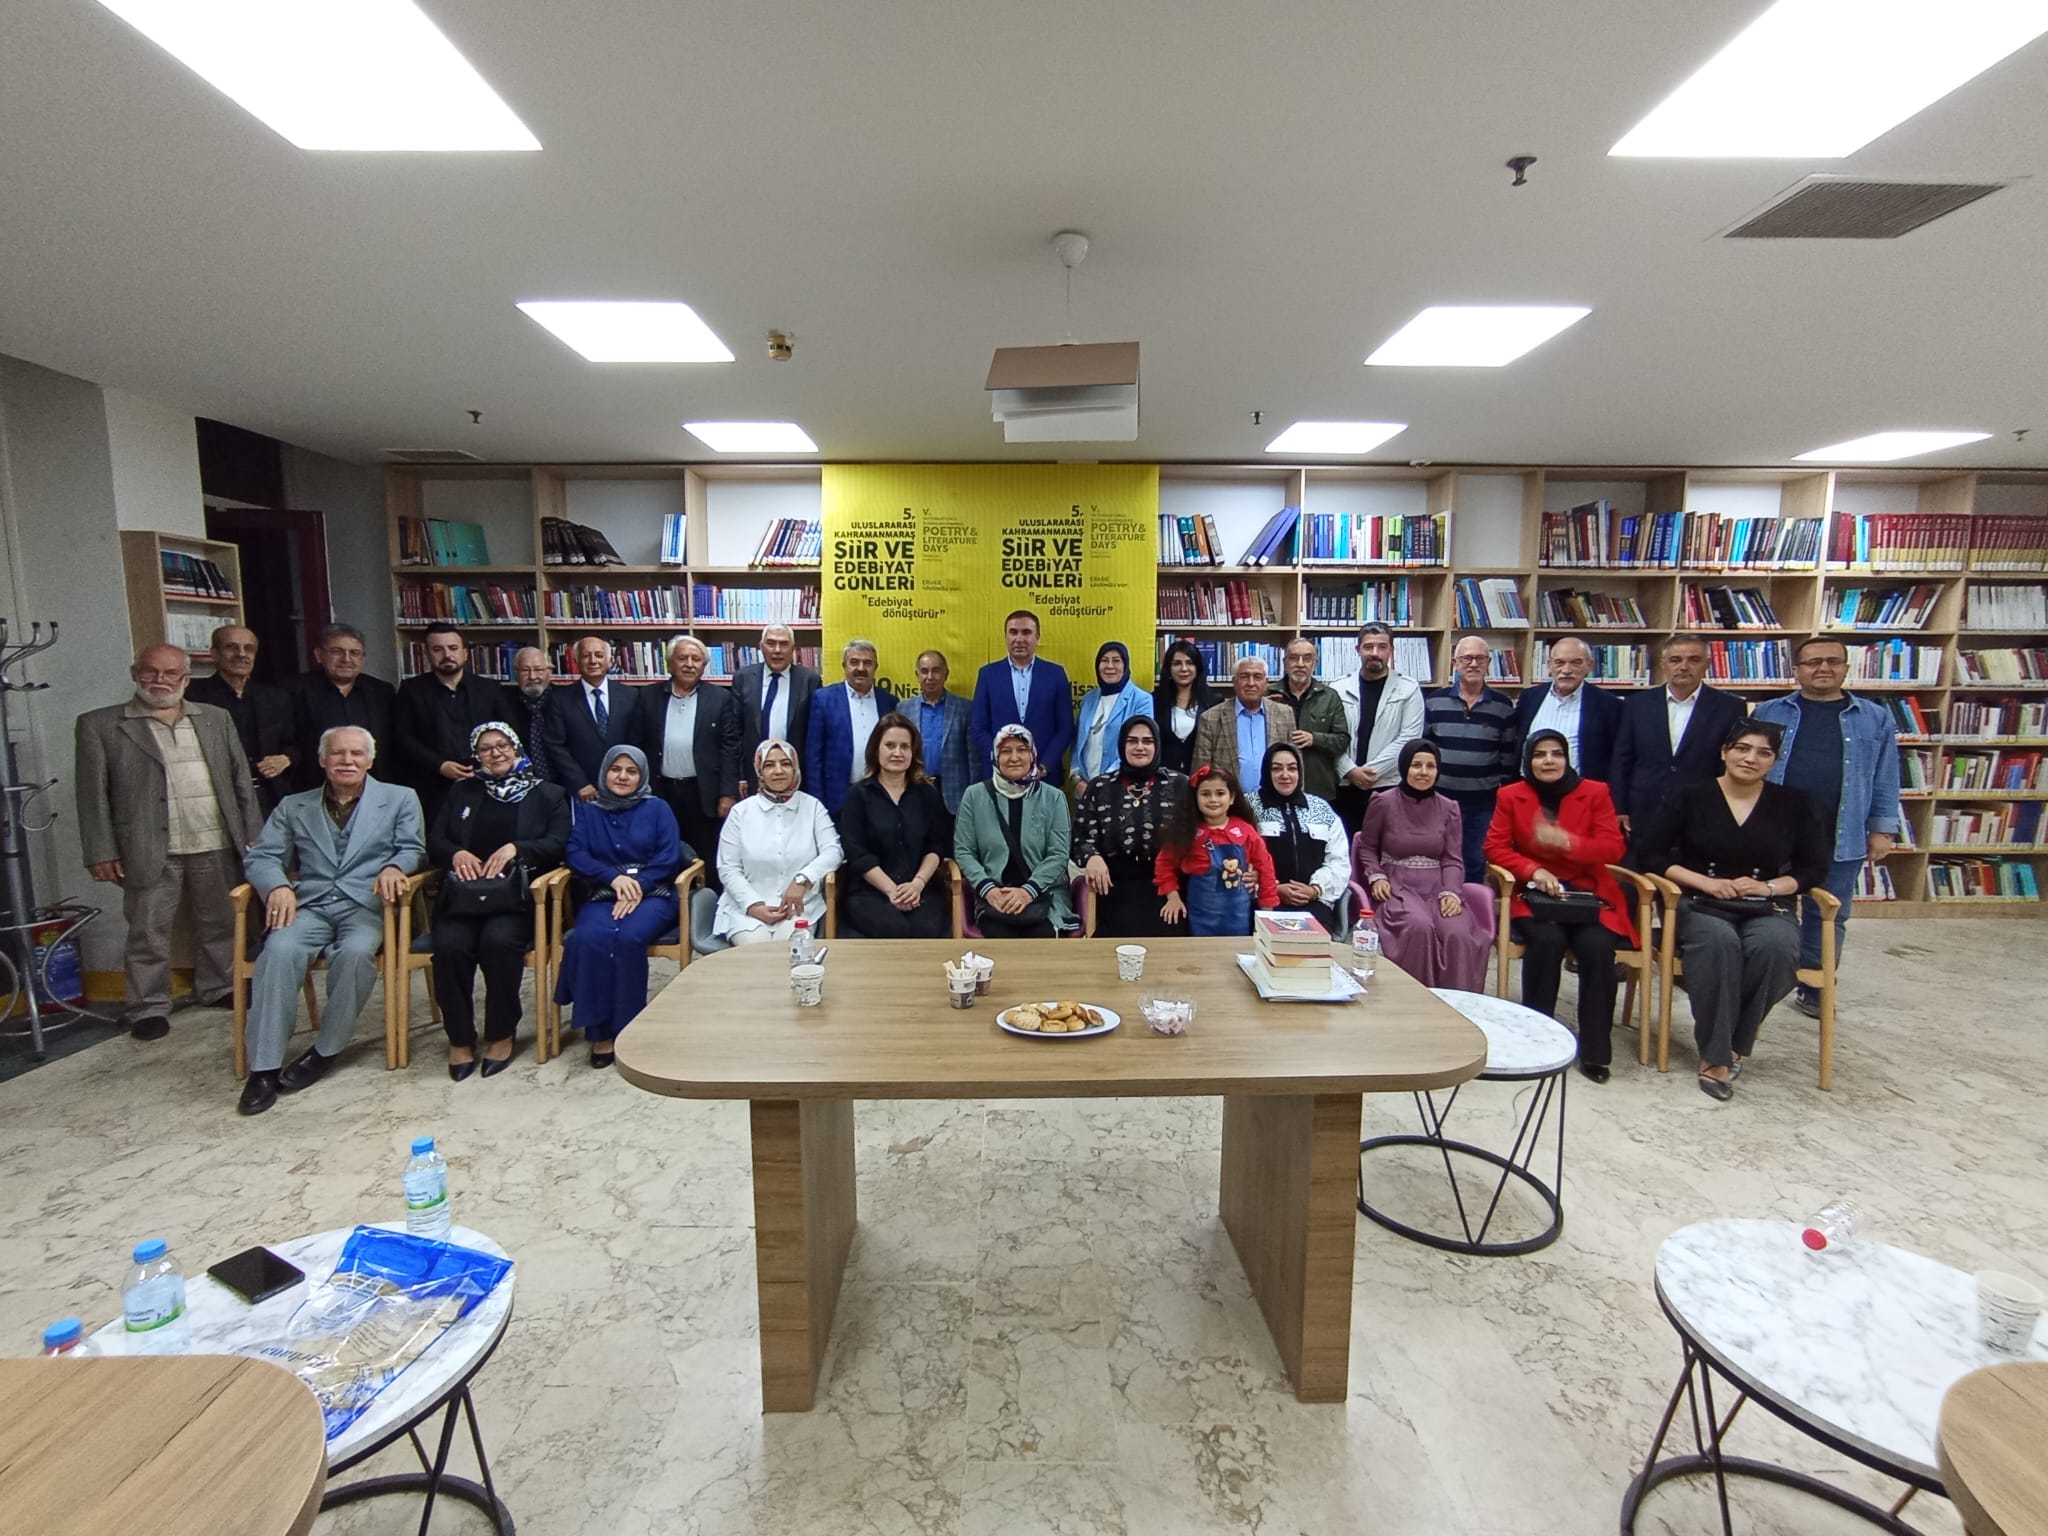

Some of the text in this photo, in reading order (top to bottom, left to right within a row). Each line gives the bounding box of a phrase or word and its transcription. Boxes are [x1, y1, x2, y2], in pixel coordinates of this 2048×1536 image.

[903, 508, 916, 520] 5.
[1071, 505, 1084, 517] 5.
[1091, 505, 1100, 513] V.
[834, 531, 916, 540] KAHRAMANMARAŞ
[1002, 528, 1084, 538] KAHRAMANMARAŞ
[885, 541, 915, 559] VE
[1052, 538, 1083, 556] VE
[1091, 541, 1117, 549] DAYS
[834, 561, 915, 574] EDEBİYAT
[1002, 559, 1083, 571] EDEBİYAT
[834, 576, 915, 590] GÜNLERİ
[1002, 573, 1083, 588] GÜNLERİ
[895, 683, 922, 699] Nis
